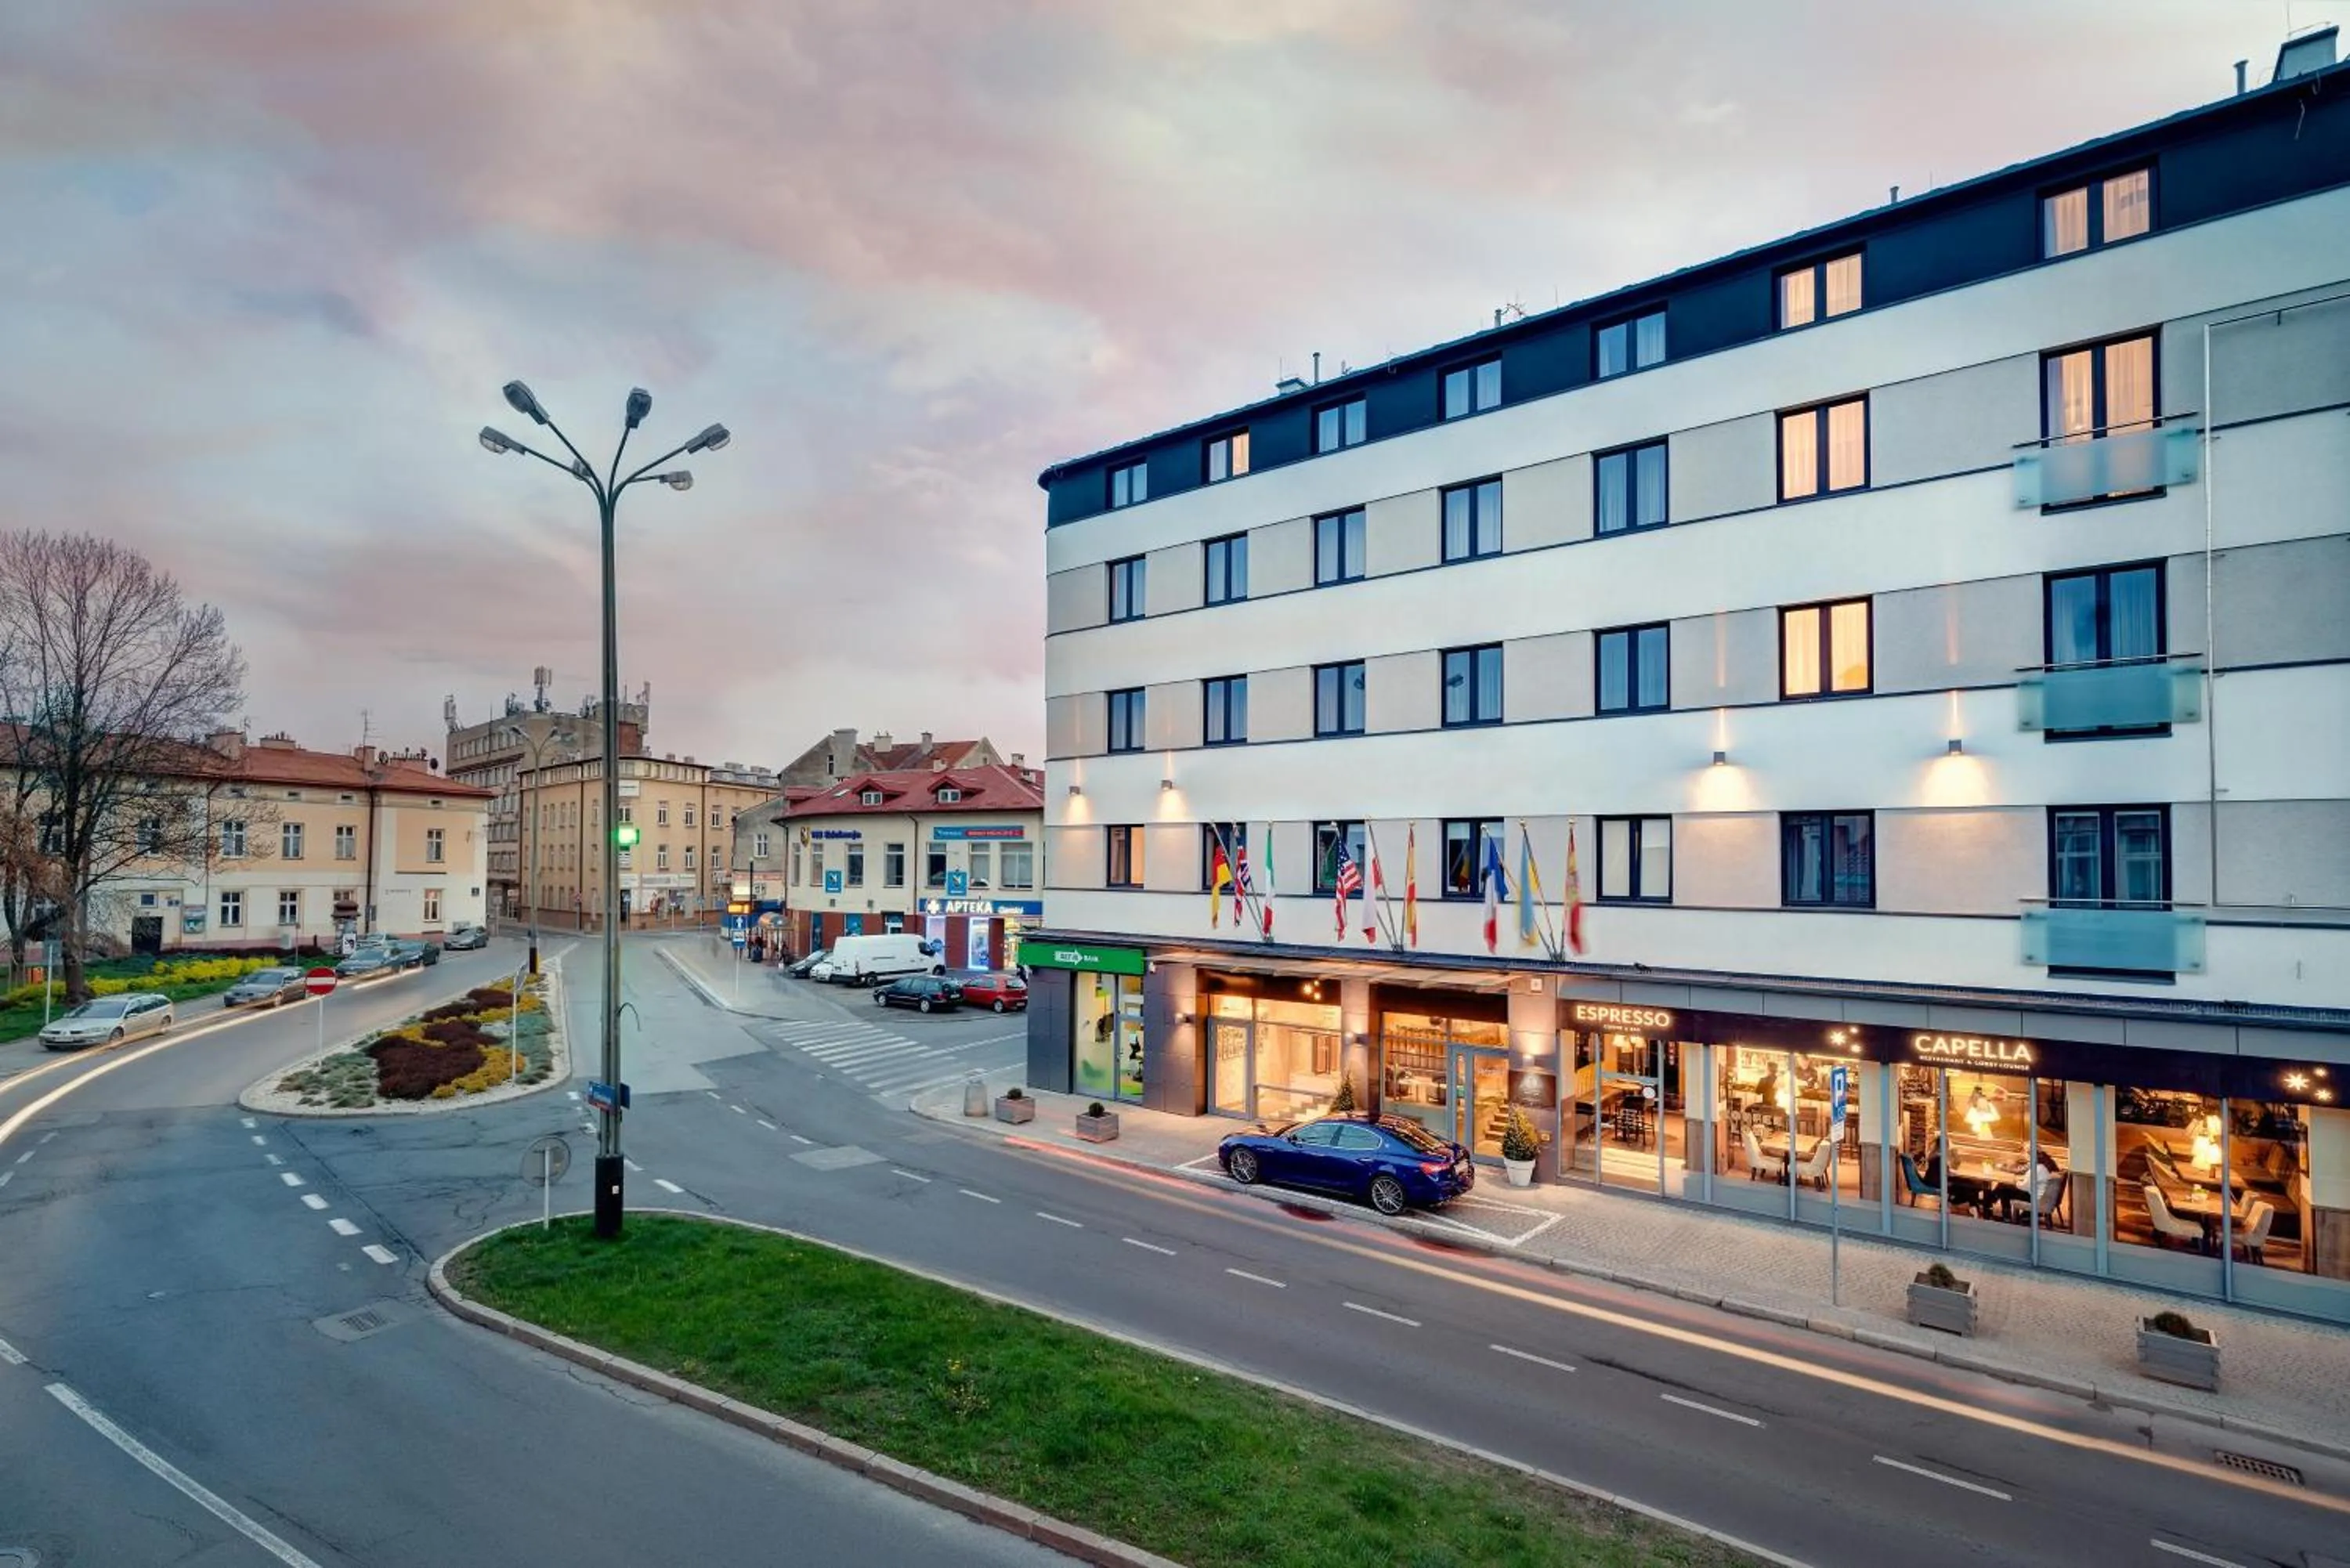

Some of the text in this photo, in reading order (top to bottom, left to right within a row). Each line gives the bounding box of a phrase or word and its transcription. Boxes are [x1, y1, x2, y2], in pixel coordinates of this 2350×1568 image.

[945, 901, 992, 914] APTEKA
[1576, 1005, 1670, 1028] ESPRESSO
[1914, 1035, 2032, 1062] CAPELLA
[1919, 1054, 1964, 1064] RESTAURANT
[1998, 1063, 2030, 1071] LOUNGE
[1834, 1072, 1844, 1107] P
